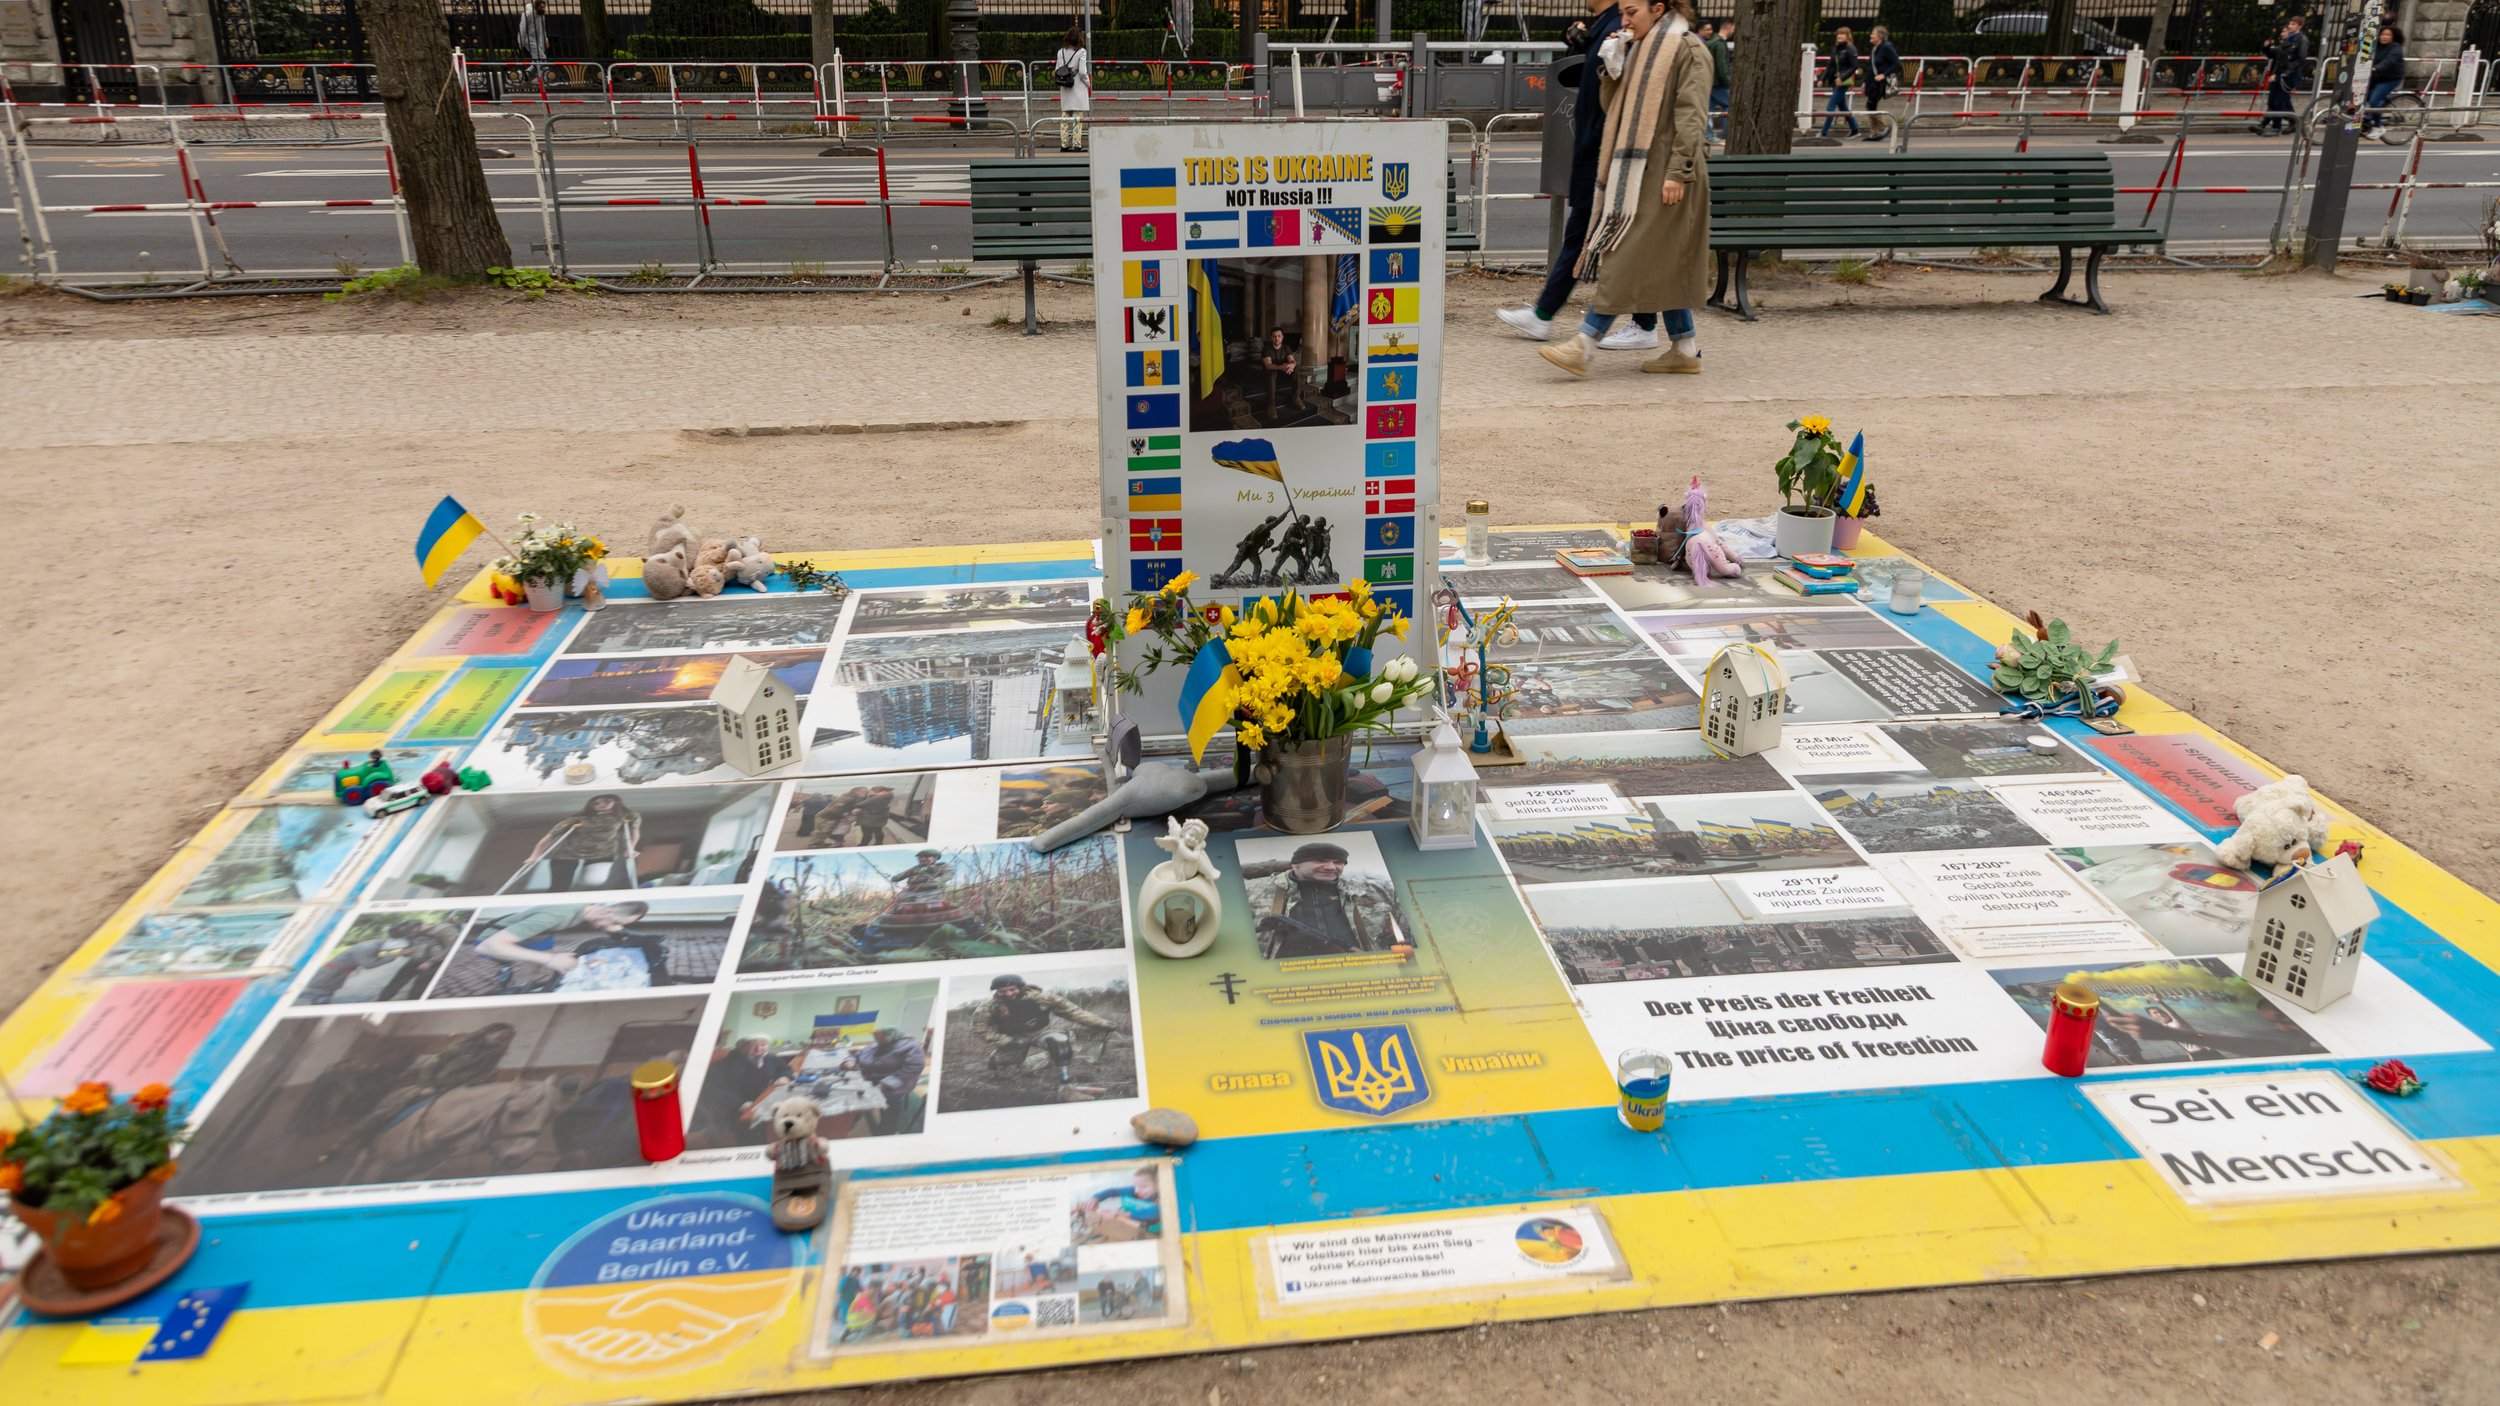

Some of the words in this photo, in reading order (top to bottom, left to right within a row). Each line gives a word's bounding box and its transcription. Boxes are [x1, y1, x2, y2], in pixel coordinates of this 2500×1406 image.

[1183, 157, 1239, 185] THIS
[1244, 156, 1268, 184] IS
[1273, 154, 1373, 183] UKRAINE
[1226, 189, 1256, 207] NOT
[1260, 188, 1313, 206] Russia
[1317, 188, 1332, 204] !!!
[1237, 489, 1262, 502] Ми
[1292, 486, 1355, 500] України!
[2185, 748, 2257, 791] criminals
[2187, 768, 2223, 789] with
[2157, 769, 2214, 803] bloody
[1516, 806, 1551, 814] killed
[1555, 804, 1608, 812] civilians
[1550, 796, 1609, 805] Zivilisten
[2031, 804, 2153, 814] Kriegsverbrechen
[2095, 813, 2141, 821] crimes
[2212, 806, 2240, 821] No
[2079, 822, 2150, 831] registered
[1934, 871, 2000, 881] zerstörte
[2003, 869, 2041, 878] zivile
[1963, 880, 2034, 890] Gebäude
[1753, 889, 1816, 898] verletzte
[1819, 886, 1885, 895] Zivilisten
[1770, 898, 1821, 908] injured
[1826, 896, 1885, 904] civilians
[1947, 893, 2000, 902] civilian
[2001, 889, 2071, 899] buildings
[1982, 900, 2059, 911] destroyed
[1643, 1000, 1694, 1017] Der
[1697, 994, 1773, 1013] Preis
[1775, 992, 1822, 1009] der
[1823, 984, 1936, 1006] Freiheit
[1705, 1018, 1776, 1039] Ціна
[1777, 1012, 1908, 1033] свободи
[1675, 1050, 1733, 1069] The
[1735, 1045, 1816, 1067] price
[1818, 1041, 1851, 1059] of
[1852, 1033, 1978, 1059] freedom
[1210, 1072, 1291, 1092] Слава
[1440, 1052, 1543, 1072] України
[2130, 1089, 2235, 1124] Sei
[2245, 1084, 2342, 1117] ein
[2160, 1140, 2431, 1186] Mensch.
[626, 1207, 754, 1231] Ukraine-
[609, 1228, 756, 1256] Saarland-
[1280, 1252, 1303, 1264] Wir
[1306, 1249, 1355, 1261] bleiben
[1358, 1245, 1383, 1256] hier
[1388, 1243, 1408, 1253] bis
[1412, 1241, 1440, 1250] zum
[1443, 1237, 1472, 1249] Sieg
[1293, 1240, 1315, 1251] Wir
[1320, 1238, 1347, 1249] sind
[1351, 1234, 1371, 1244] die
[1375, 1228, 1453, 1243] Mahnwache
[597, 1257, 689, 1283] Berlin
[697, 1251, 750, 1272] e.V.
[1309, 1261, 1343, 1273] ohne
[1347, 1251, 1445, 1268] Kompromisse!
[1304, 1271, 1419, 1290] Ukraine-Mahnwache
[1422, 1267, 1455, 1278] Berlin
